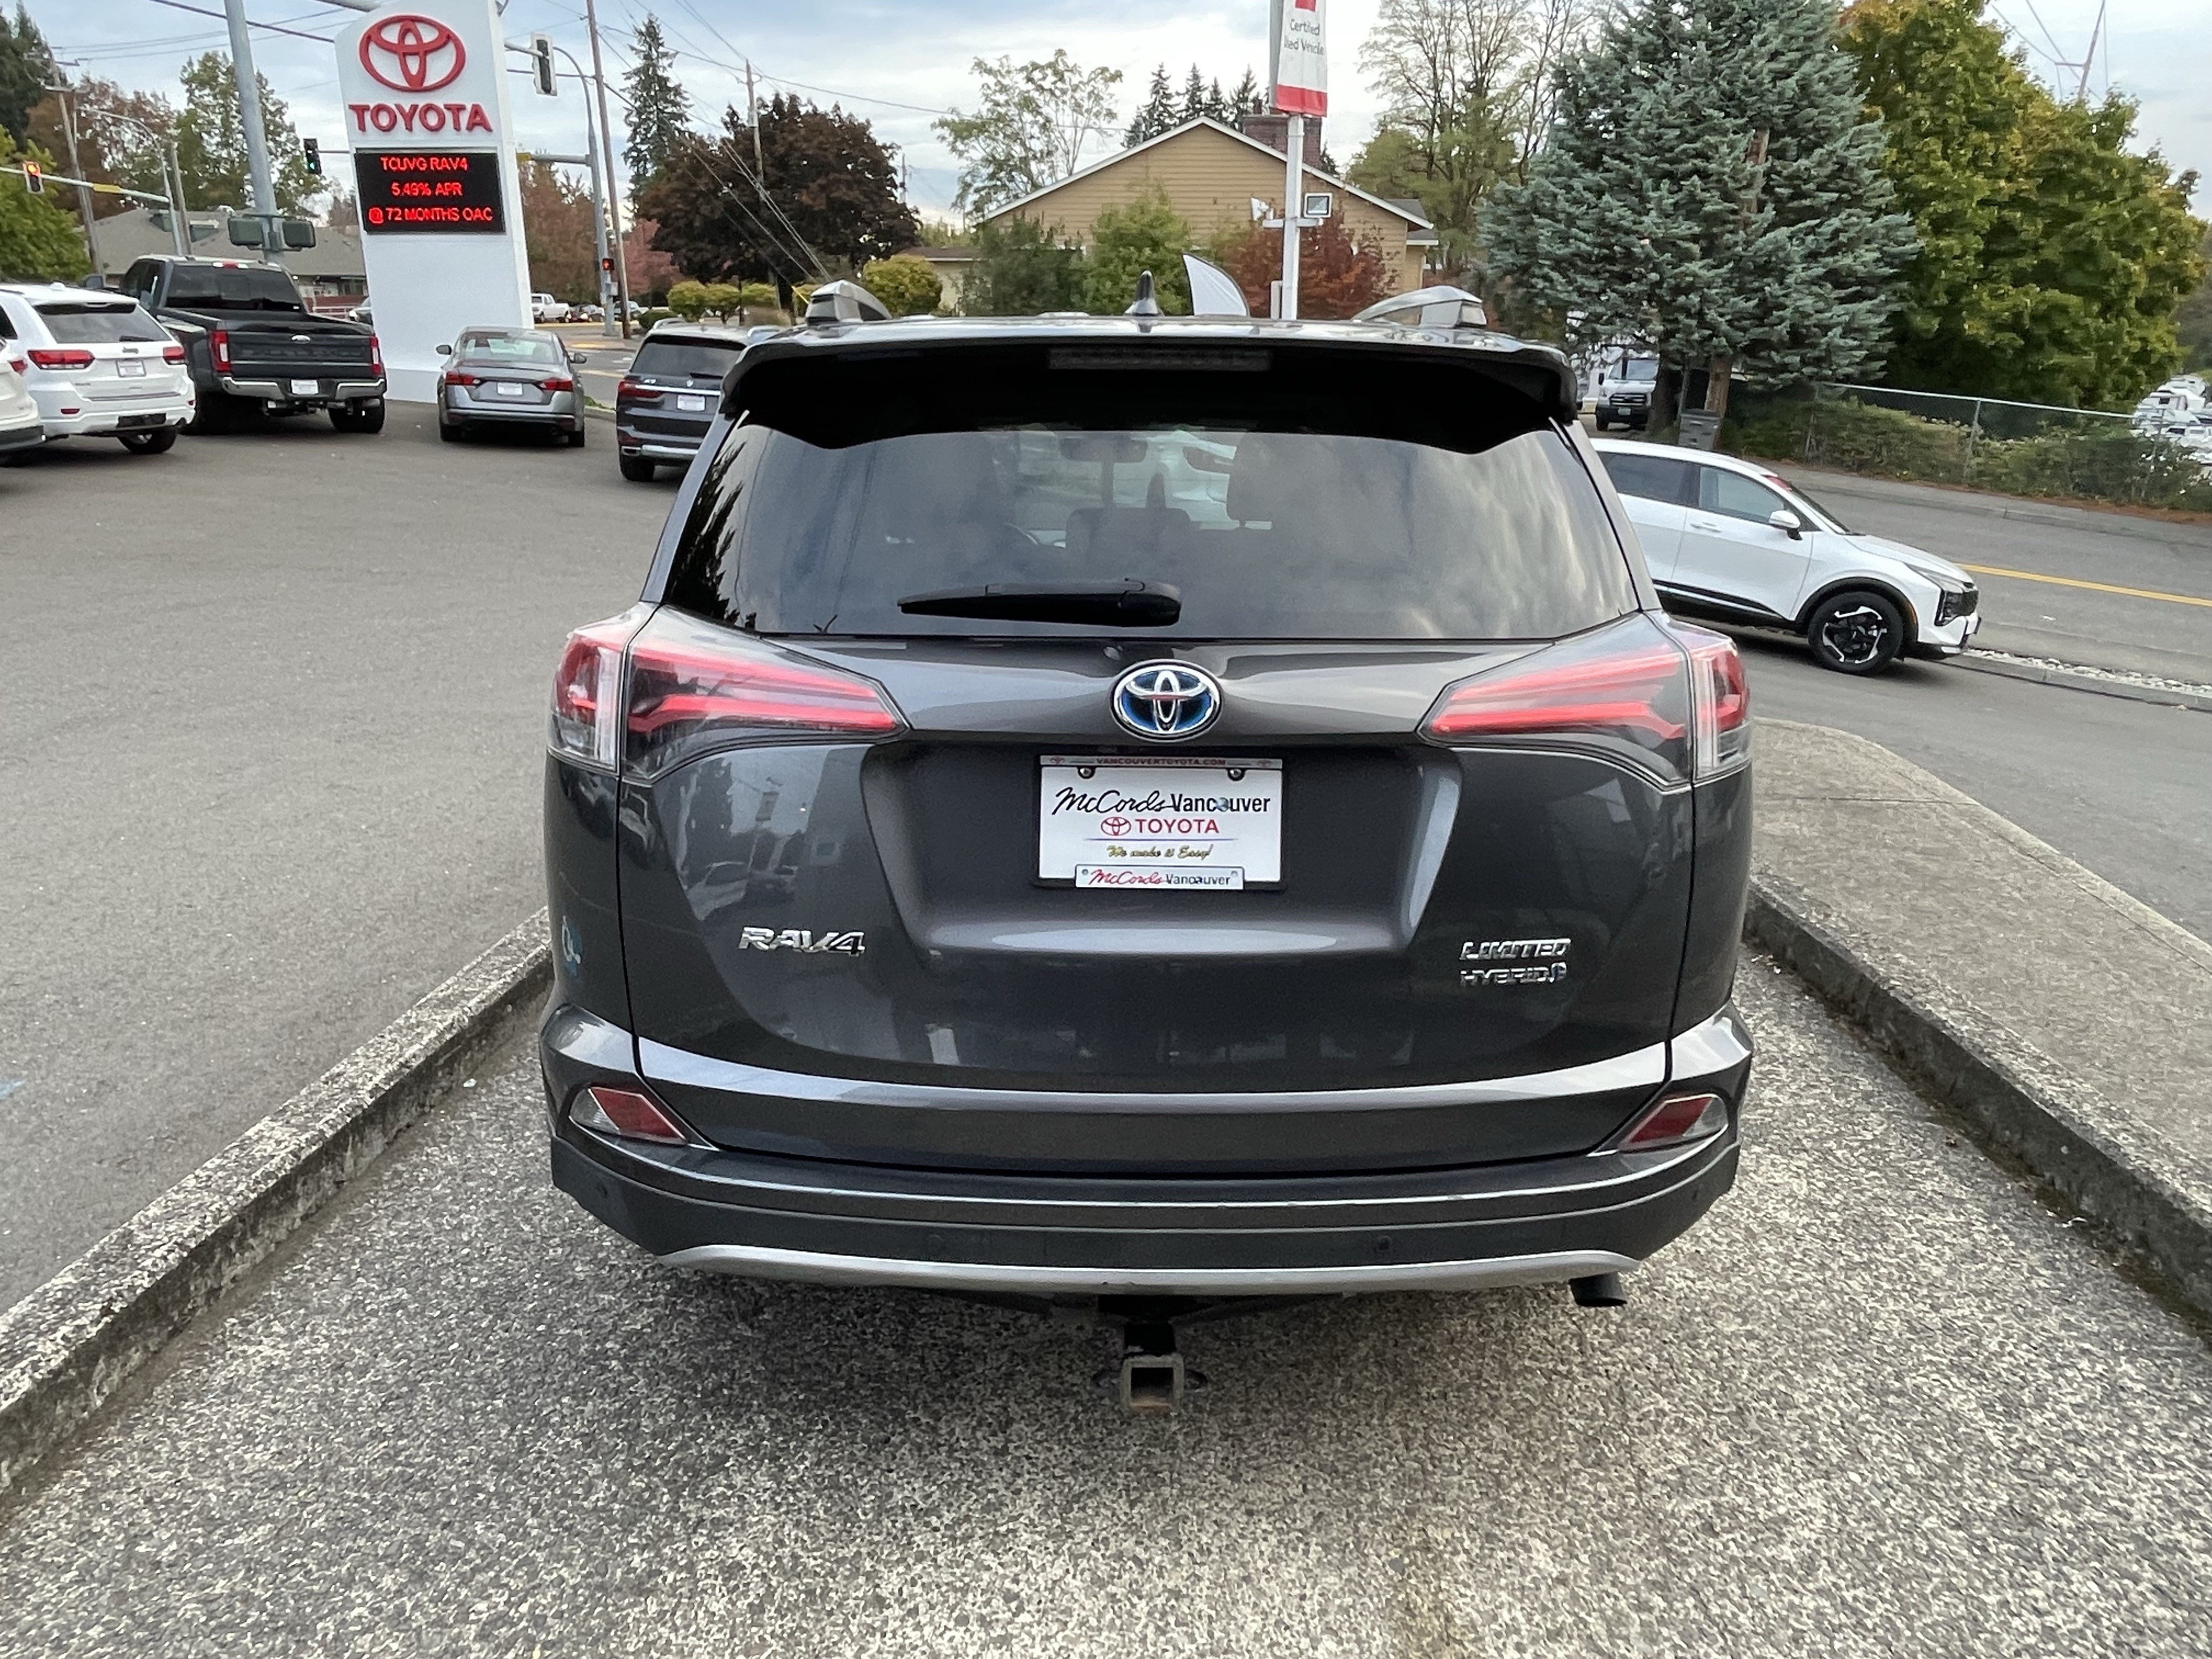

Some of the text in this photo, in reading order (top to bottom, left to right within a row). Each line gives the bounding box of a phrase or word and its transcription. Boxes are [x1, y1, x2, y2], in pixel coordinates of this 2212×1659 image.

[348, 103, 493, 133] TOYOTA
[430, 156, 469, 172] RAV4
[391, 182, 463, 196] 5.49% APR
[369, 206, 493, 224] @ 72 MONTHS OAC
[1096, 757, 1226, 766] VANCOUVERTOYOTA.COM
[1051, 787, 1271, 815] McCords Vancouver
[1135, 819, 1220, 834] TOYOTA
[1088, 869, 1231, 885] McCords Vancouver
[738, 926, 866, 957] RAV4
[1459, 938, 1571, 960] LIMITED
[1460, 967, 1549, 986] HYBRID
